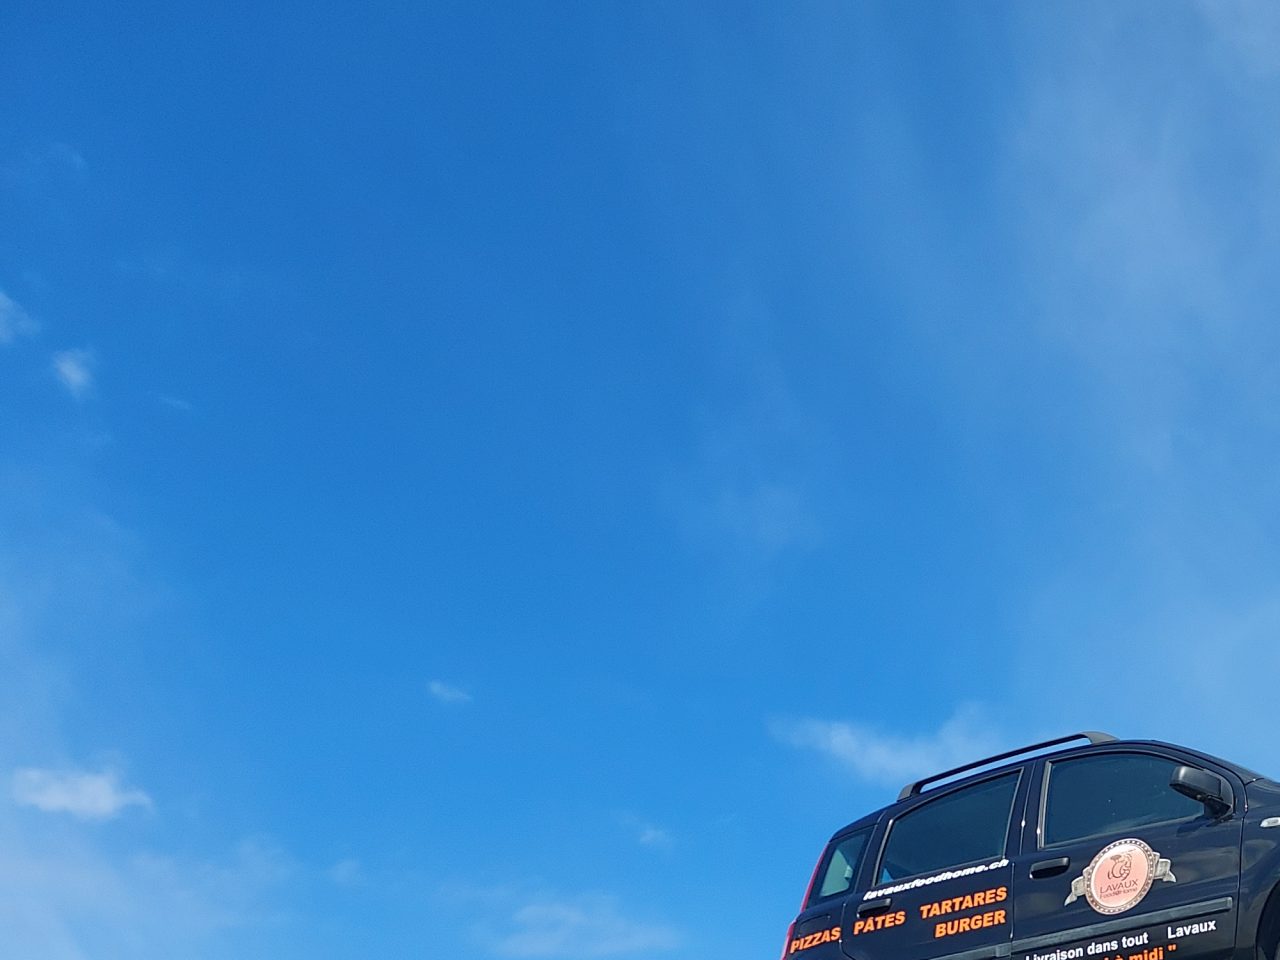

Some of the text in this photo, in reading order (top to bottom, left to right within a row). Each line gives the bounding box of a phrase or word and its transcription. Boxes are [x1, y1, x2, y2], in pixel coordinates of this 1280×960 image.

[863, 858, 1010, 901] lavauxfoodhome.ch
[1100, 879, 1139, 894] LAVAUX
[789, 926, 842, 954] PIZZAS
[920, 886, 1008, 919] TARTARES
[935, 910, 1006, 938] BURGER
[1087, 939, 1119, 955] dans
[1121, 932, 1149, 949] tout
[1167, 920, 1217, 939] Lavaux
